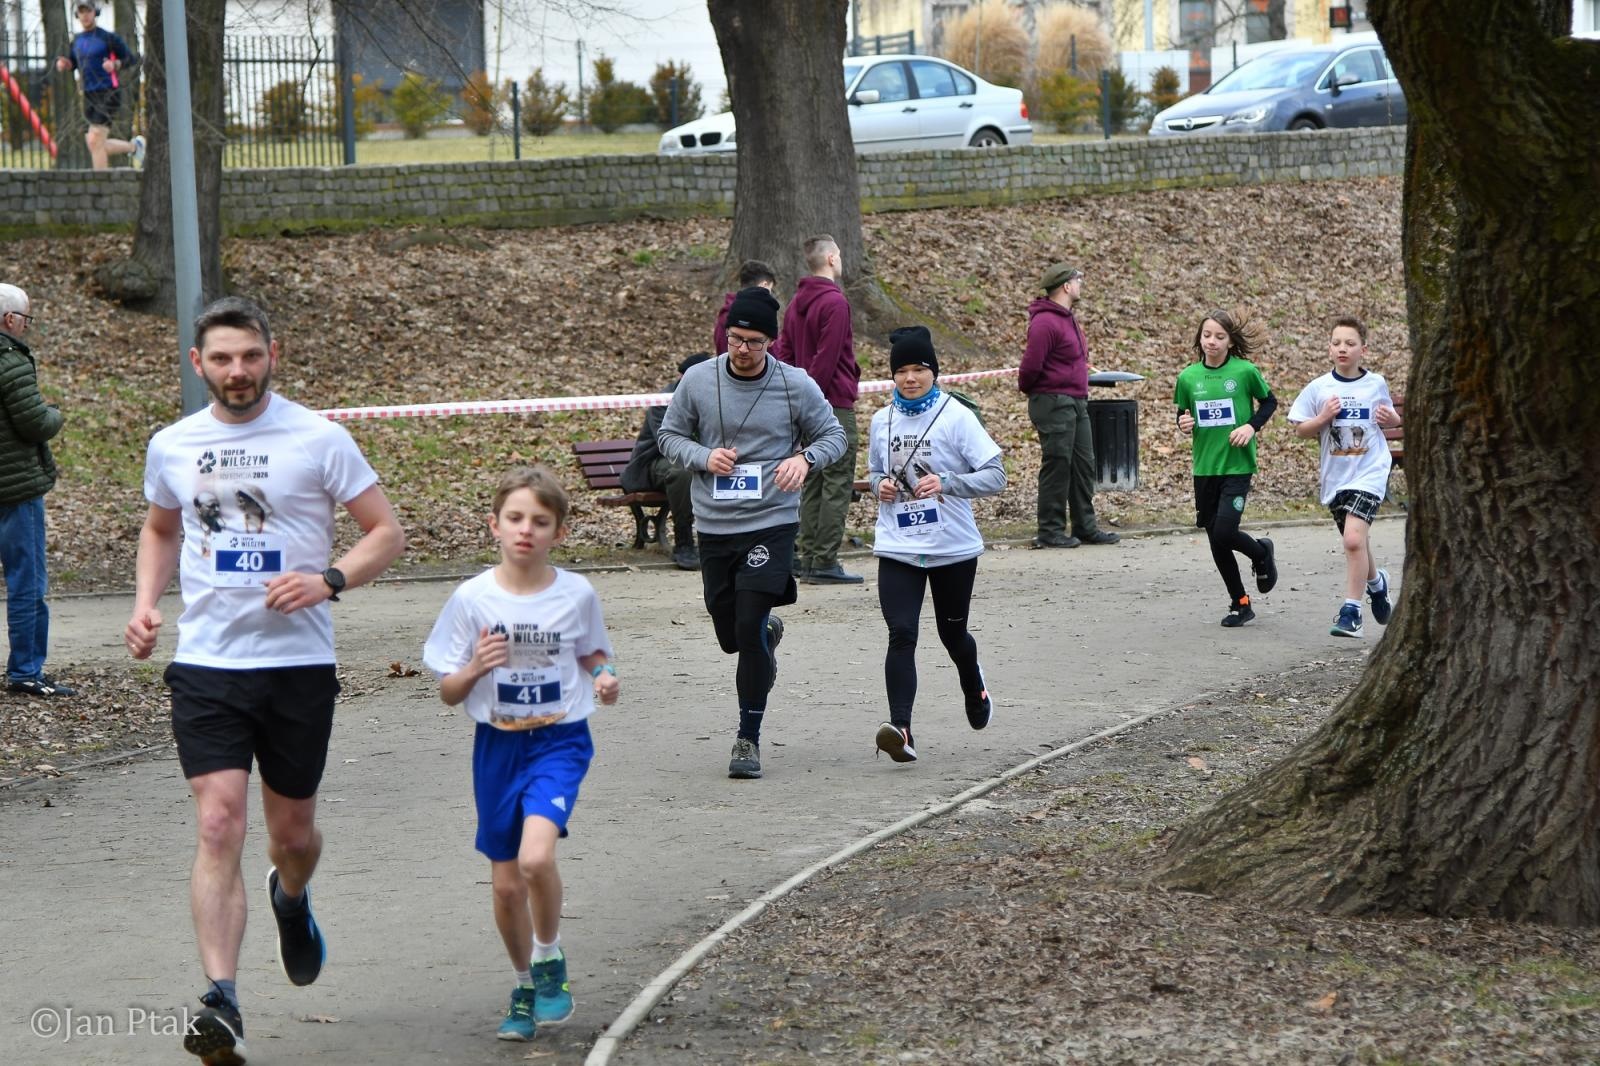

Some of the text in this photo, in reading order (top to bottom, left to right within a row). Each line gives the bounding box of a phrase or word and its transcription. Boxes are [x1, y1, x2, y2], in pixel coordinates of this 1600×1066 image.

[1208, 409, 1223, 419] 59
[1346, 409, 1361, 419] 23
[220, 456, 269, 467] WILCZYM
[729, 477, 746, 489] 76
[909, 512, 927, 525] 92
[236, 552, 264, 571] 40
[513, 632, 561, 643] WILCZYM
[517, 686, 541, 703] 41
